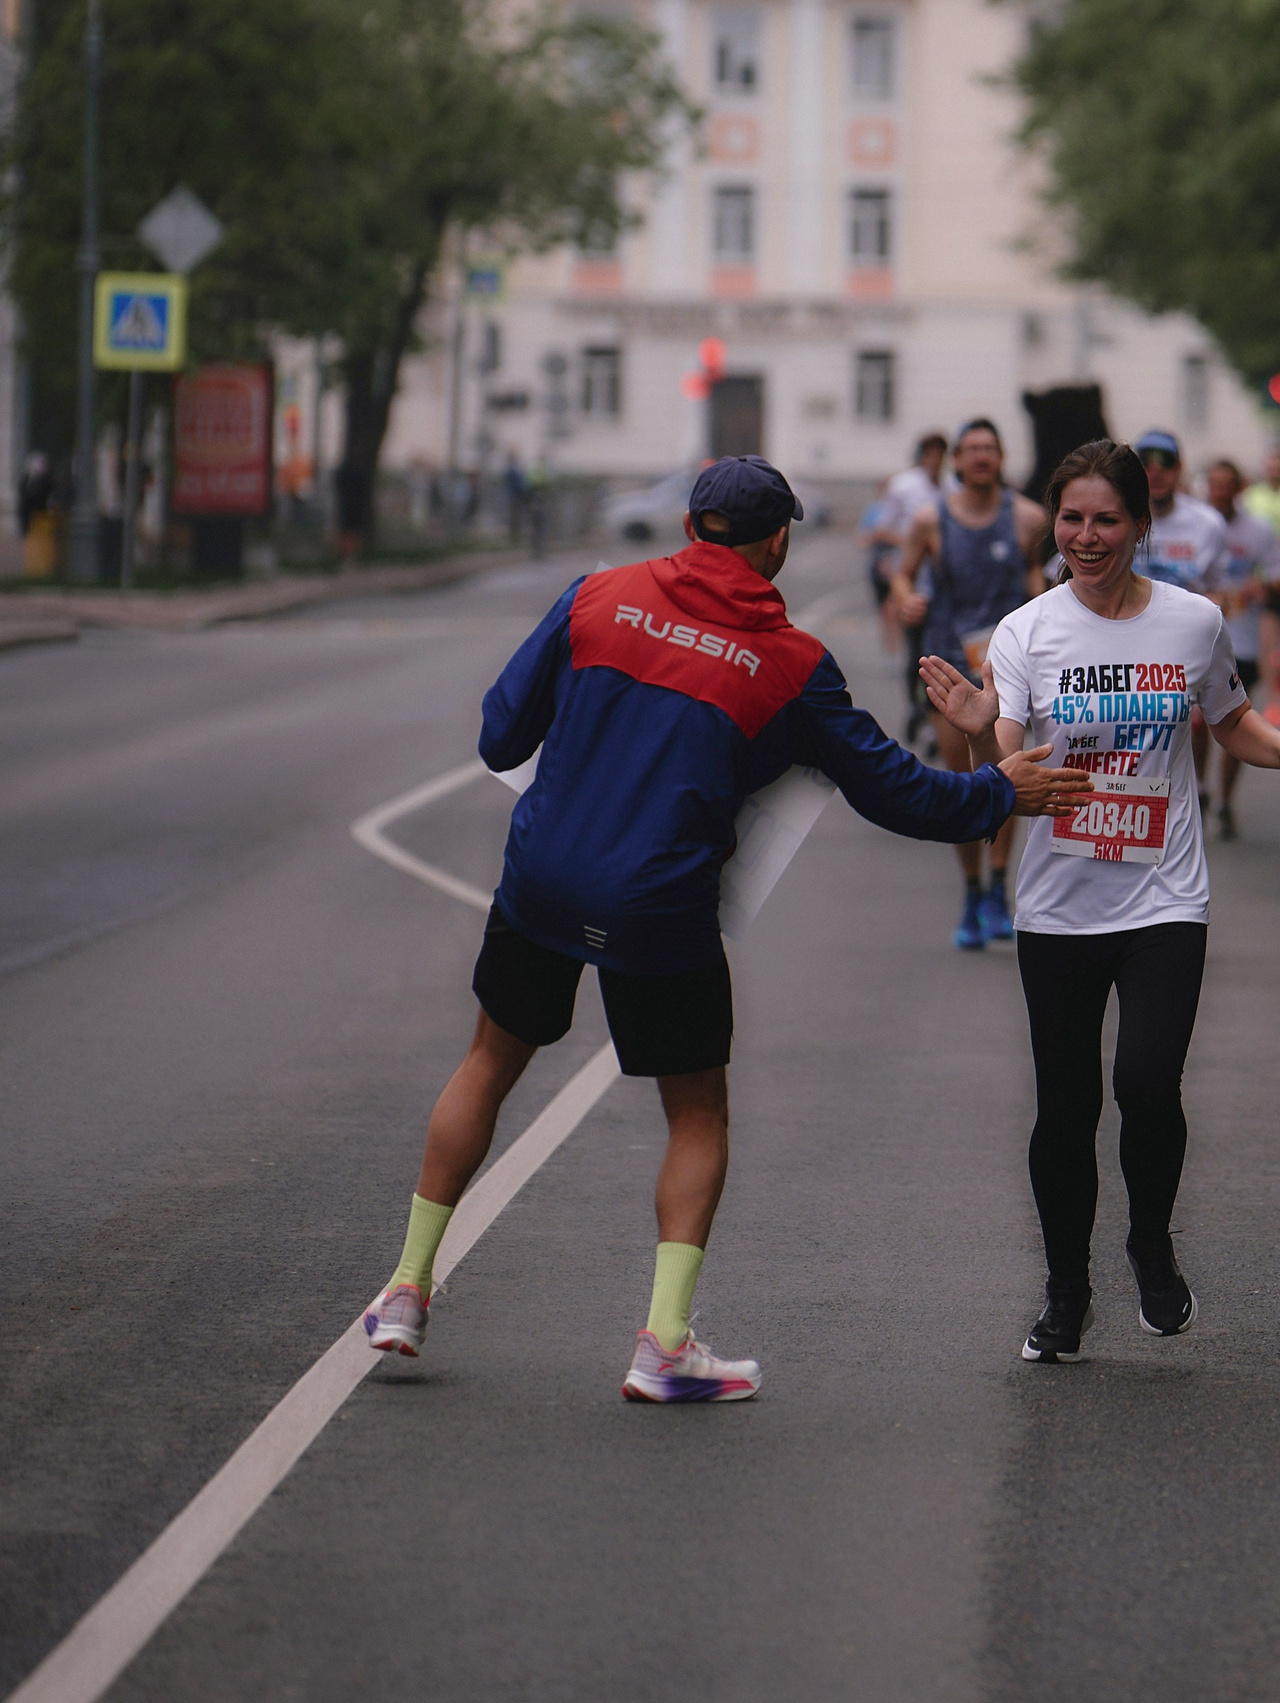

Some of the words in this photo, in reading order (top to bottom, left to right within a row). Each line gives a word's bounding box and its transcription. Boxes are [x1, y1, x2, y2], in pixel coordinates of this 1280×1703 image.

[614, 604, 762, 678] RUSSIA
[1058, 663, 1187, 695] #ЗАБЕГ2025
[1051, 695, 1095, 725] 45%
[1099, 693, 1190, 724] ПЛАНЕТЫ
[1113, 724, 1176, 751] БЕГУТ
[1062, 751, 1141, 777] ВМЕСТЕ
[1071, 801, 1151, 840] 20340
